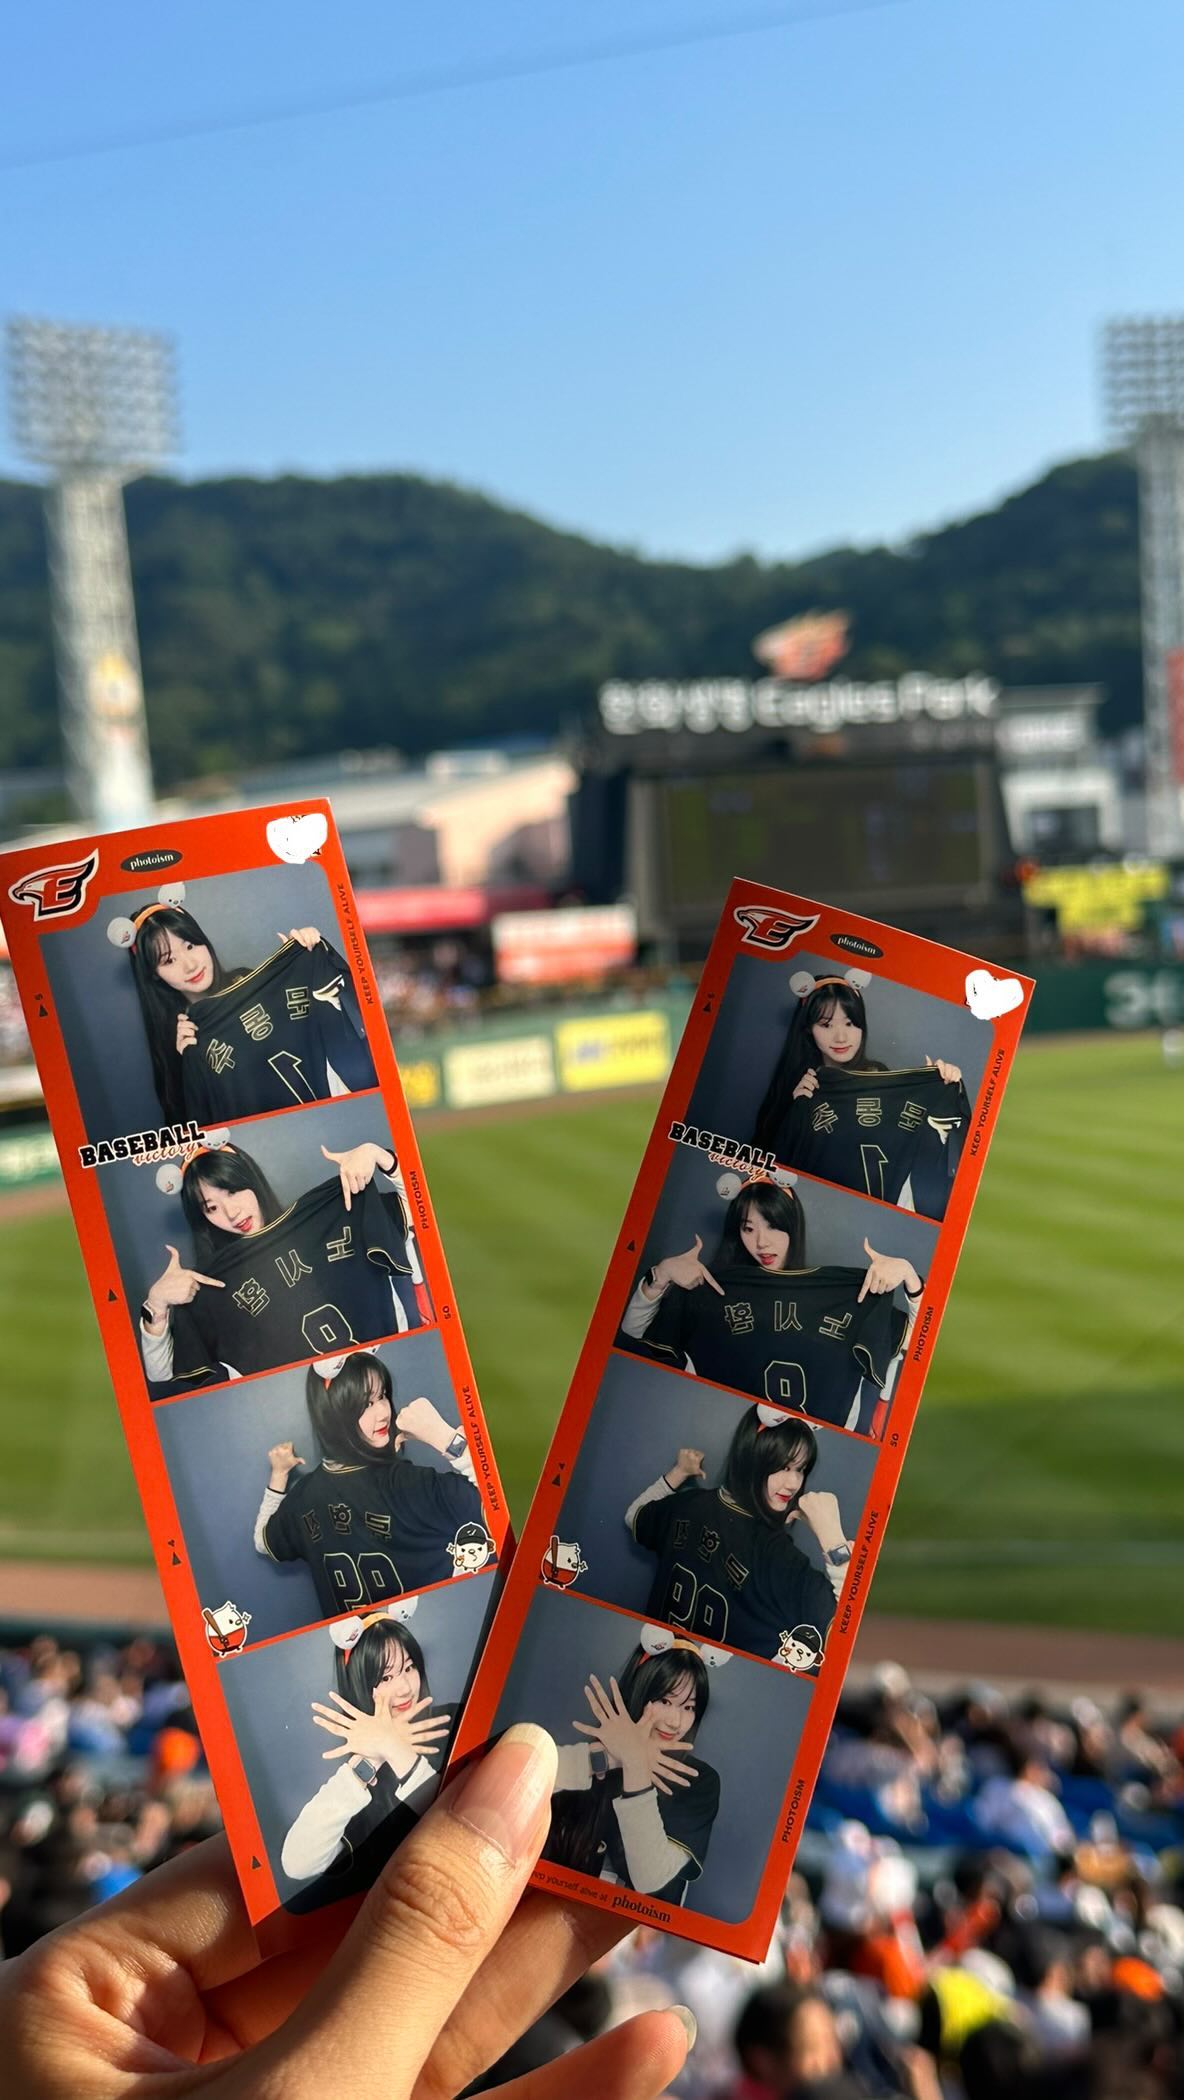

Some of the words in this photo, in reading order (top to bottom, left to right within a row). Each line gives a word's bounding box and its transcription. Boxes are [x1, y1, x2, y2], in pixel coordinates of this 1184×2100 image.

[130, 853, 174, 871] photoism
[337, 883, 351, 914] ALIVE
[347, 919, 366, 974] YOURSELF
[837, 936, 877, 955] photoism
[361, 976, 374, 1005] KEEP
[970, 1131, 983, 1157] KEEP
[977, 1079, 997, 1129] YOURSELF
[991, 1049, 1005, 1078] ALIVE
[79, 1122, 205, 1167] BASEBALL
[134, 1143, 197, 1166] victory
[669, 1122, 777, 1172] BASEBALL
[708, 1152, 766, 1181] victory
[410, 1170, 429, 1230] PHOTOISM
[913, 1306, 934, 1362] PHOTOISM
[462, 1385, 476, 1418] ALIVE
[470, 1422, 491, 1480] YOURSELF
[486, 1482, 500, 1511] KEEP
[839, 1604, 852, 1634] KEEP
[848, 1544, 869, 1603] YOURSELF
[864, 1510, 879, 1544] ALIVE
[782, 1779, 805, 1843] PHOTOISM
[546, 1876, 579, 1891] yourself
[612, 1893, 671, 1923] photoism
